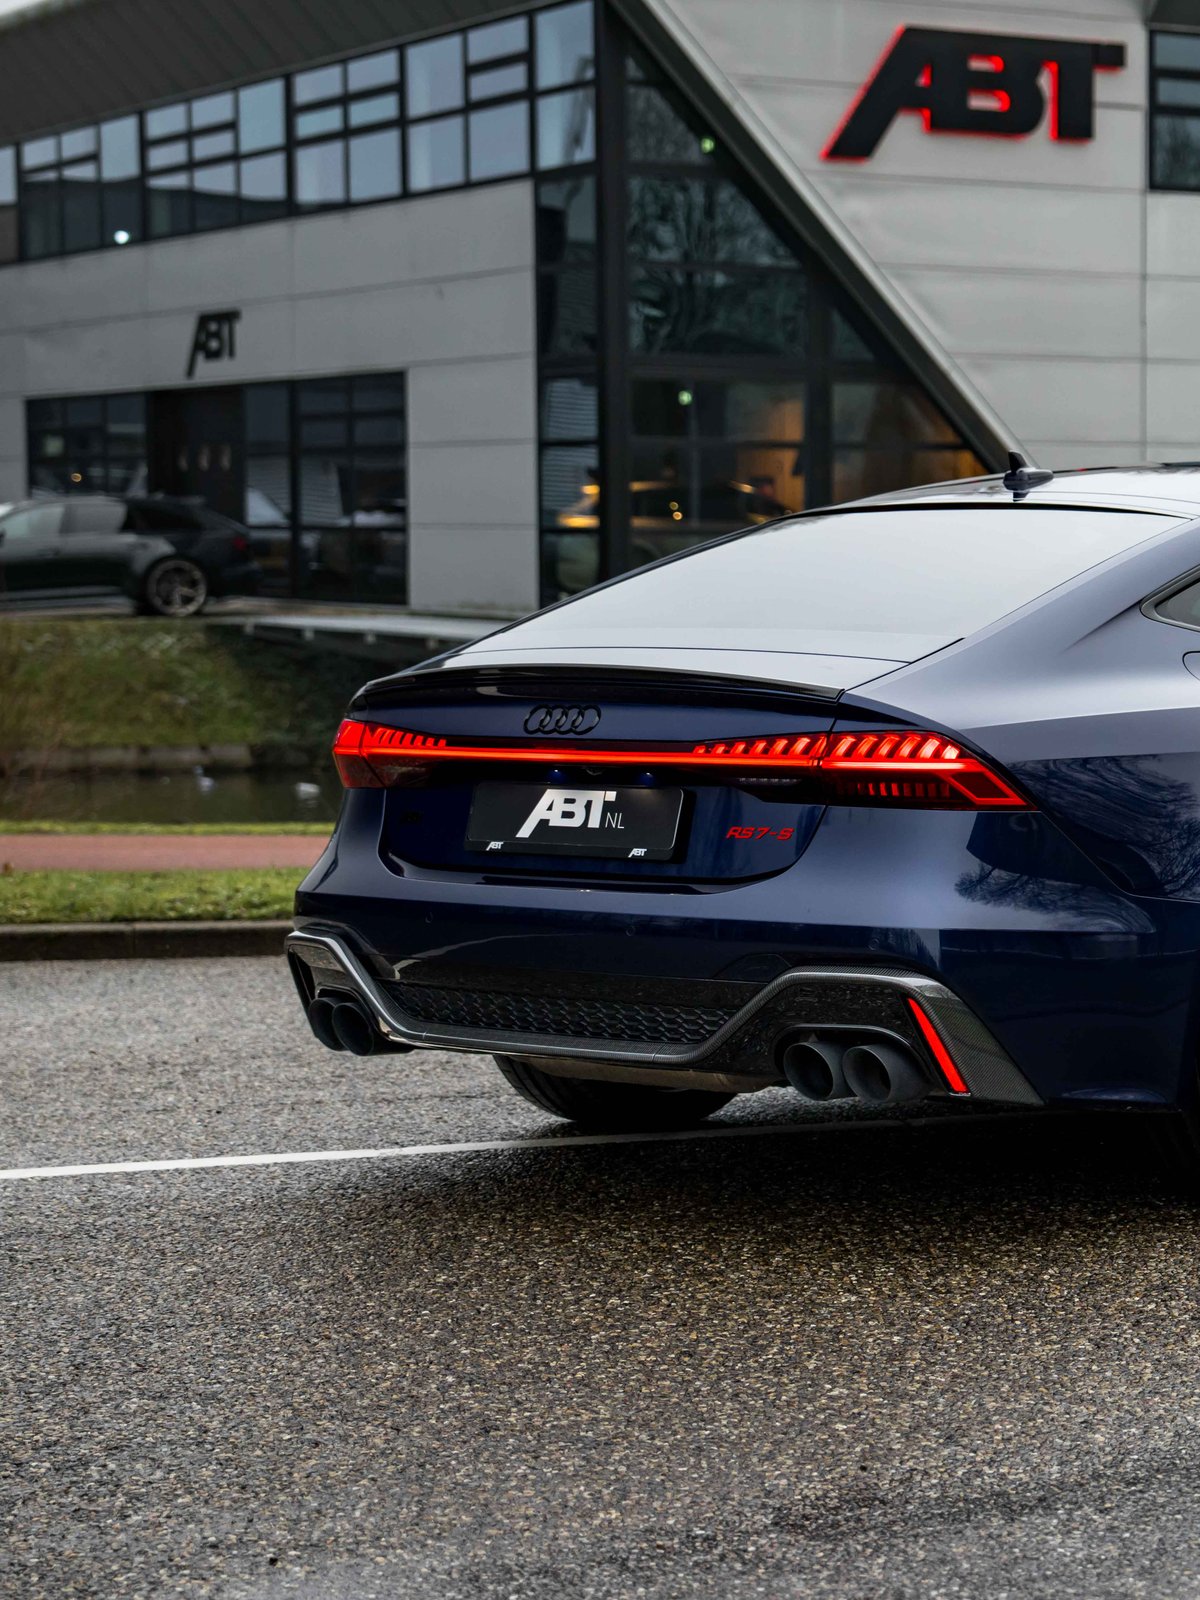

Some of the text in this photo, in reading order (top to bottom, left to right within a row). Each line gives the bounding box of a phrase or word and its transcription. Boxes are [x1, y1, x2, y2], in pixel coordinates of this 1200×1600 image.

[820, 24, 1127, 163] ABT
[186, 309, 242, 379] ABT
[515, 788, 625, 838] ABT NL
[486, 841, 504, 851] ABT
[726, 826, 795, 841] RS7-S
[627, 848, 648, 858] ABT
